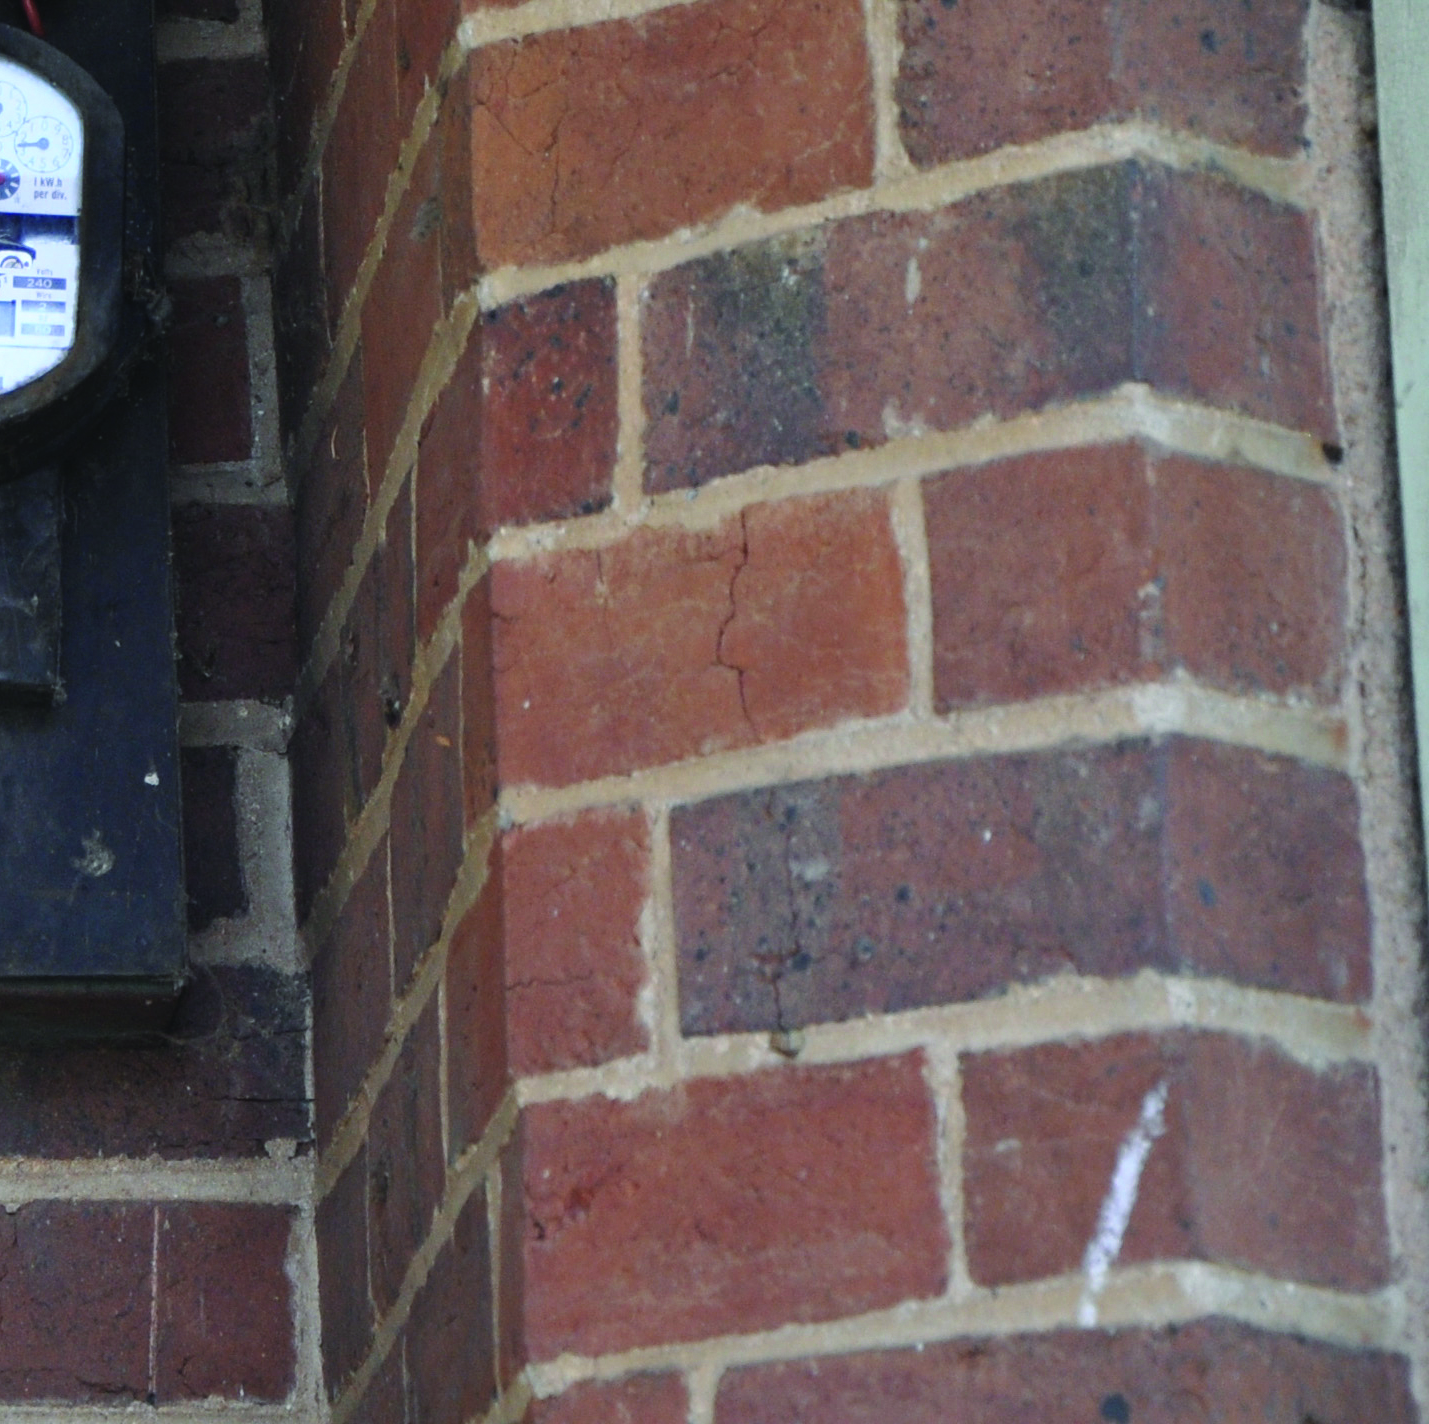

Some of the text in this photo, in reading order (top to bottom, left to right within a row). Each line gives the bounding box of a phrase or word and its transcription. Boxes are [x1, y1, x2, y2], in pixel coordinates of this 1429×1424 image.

[33, 190, 68, 201] per div.
[27, 278, 53, 289] 240
